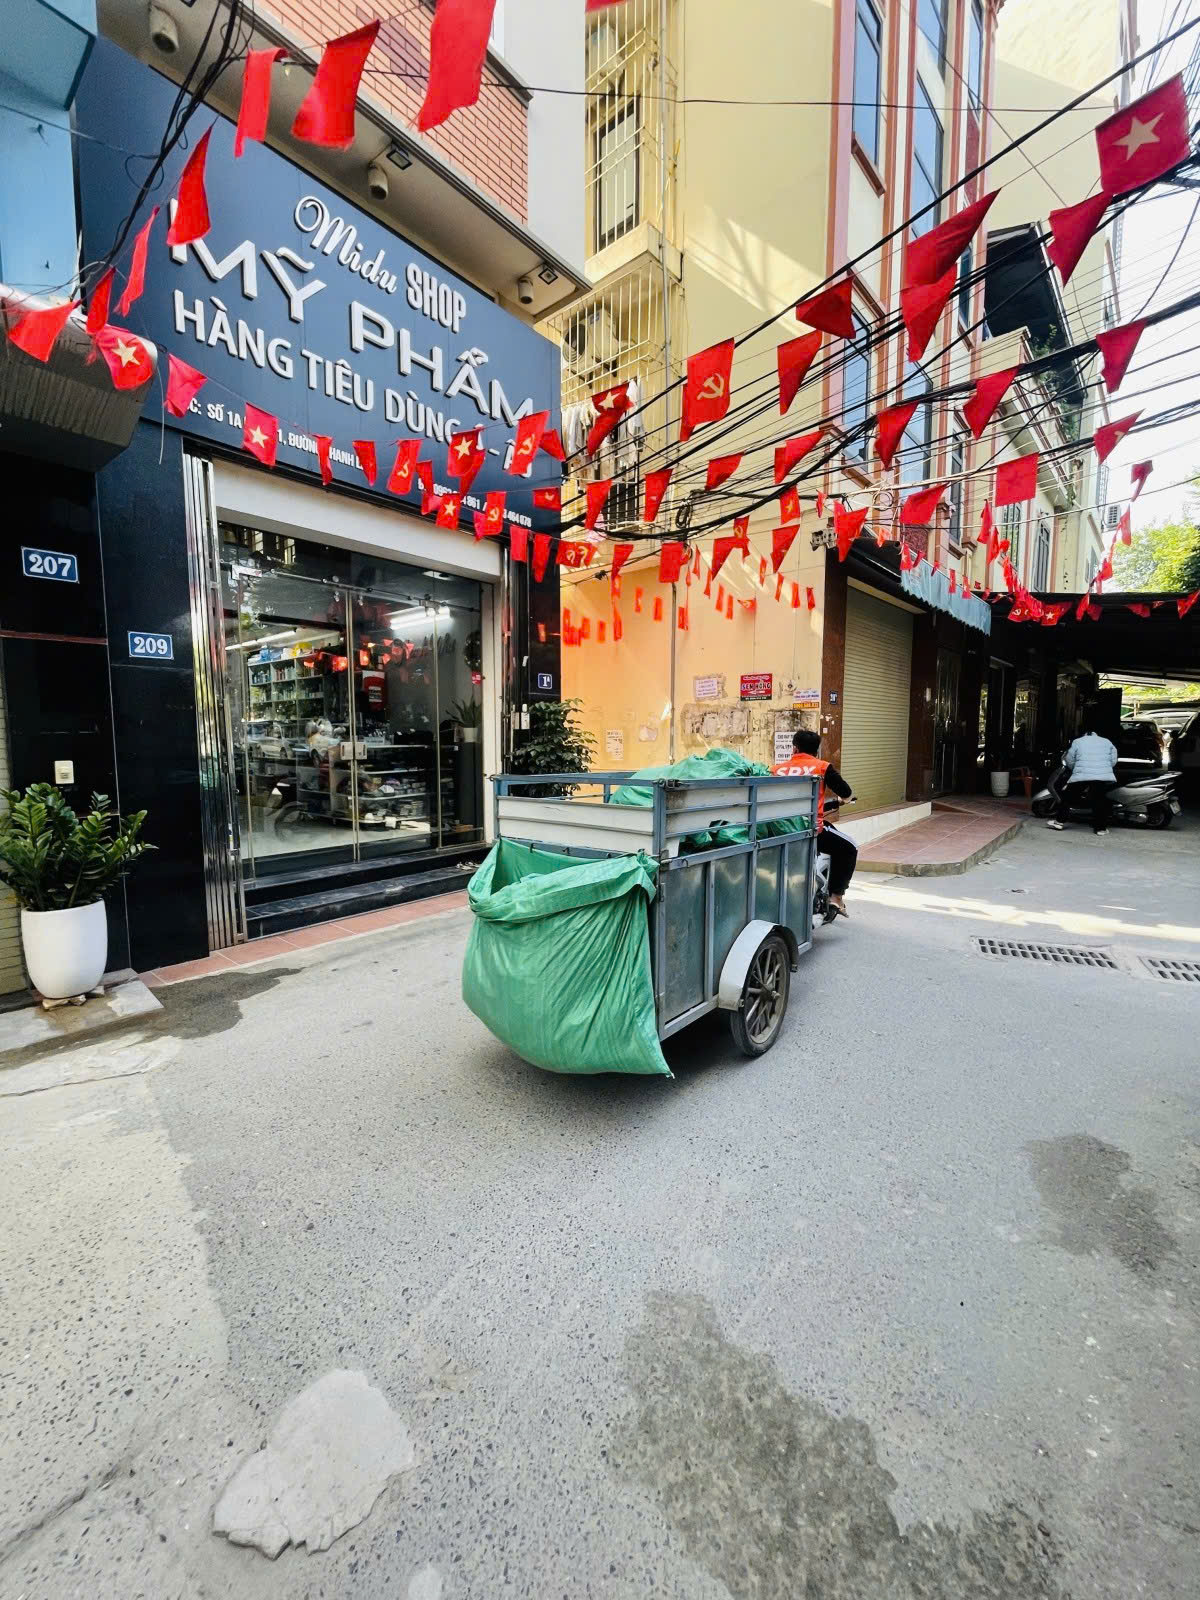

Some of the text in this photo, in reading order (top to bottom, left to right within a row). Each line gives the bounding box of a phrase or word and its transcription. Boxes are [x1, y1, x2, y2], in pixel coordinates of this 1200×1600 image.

[294, 195, 467, 333] Midu SHOP
[169, 198, 533, 427] MỸ PHẨM
[174, 289, 295, 378] HÀNG
[301, 349, 374, 411] TIÊU
[207, 403, 225, 422] SỐ
[227, 410, 243, 429] 1A
[288, 432, 319, 456] ĐƯỜN
[329, 448, 355, 467] HANH
[28, 553, 72, 577] 207
[133, 636, 168, 656] 209
